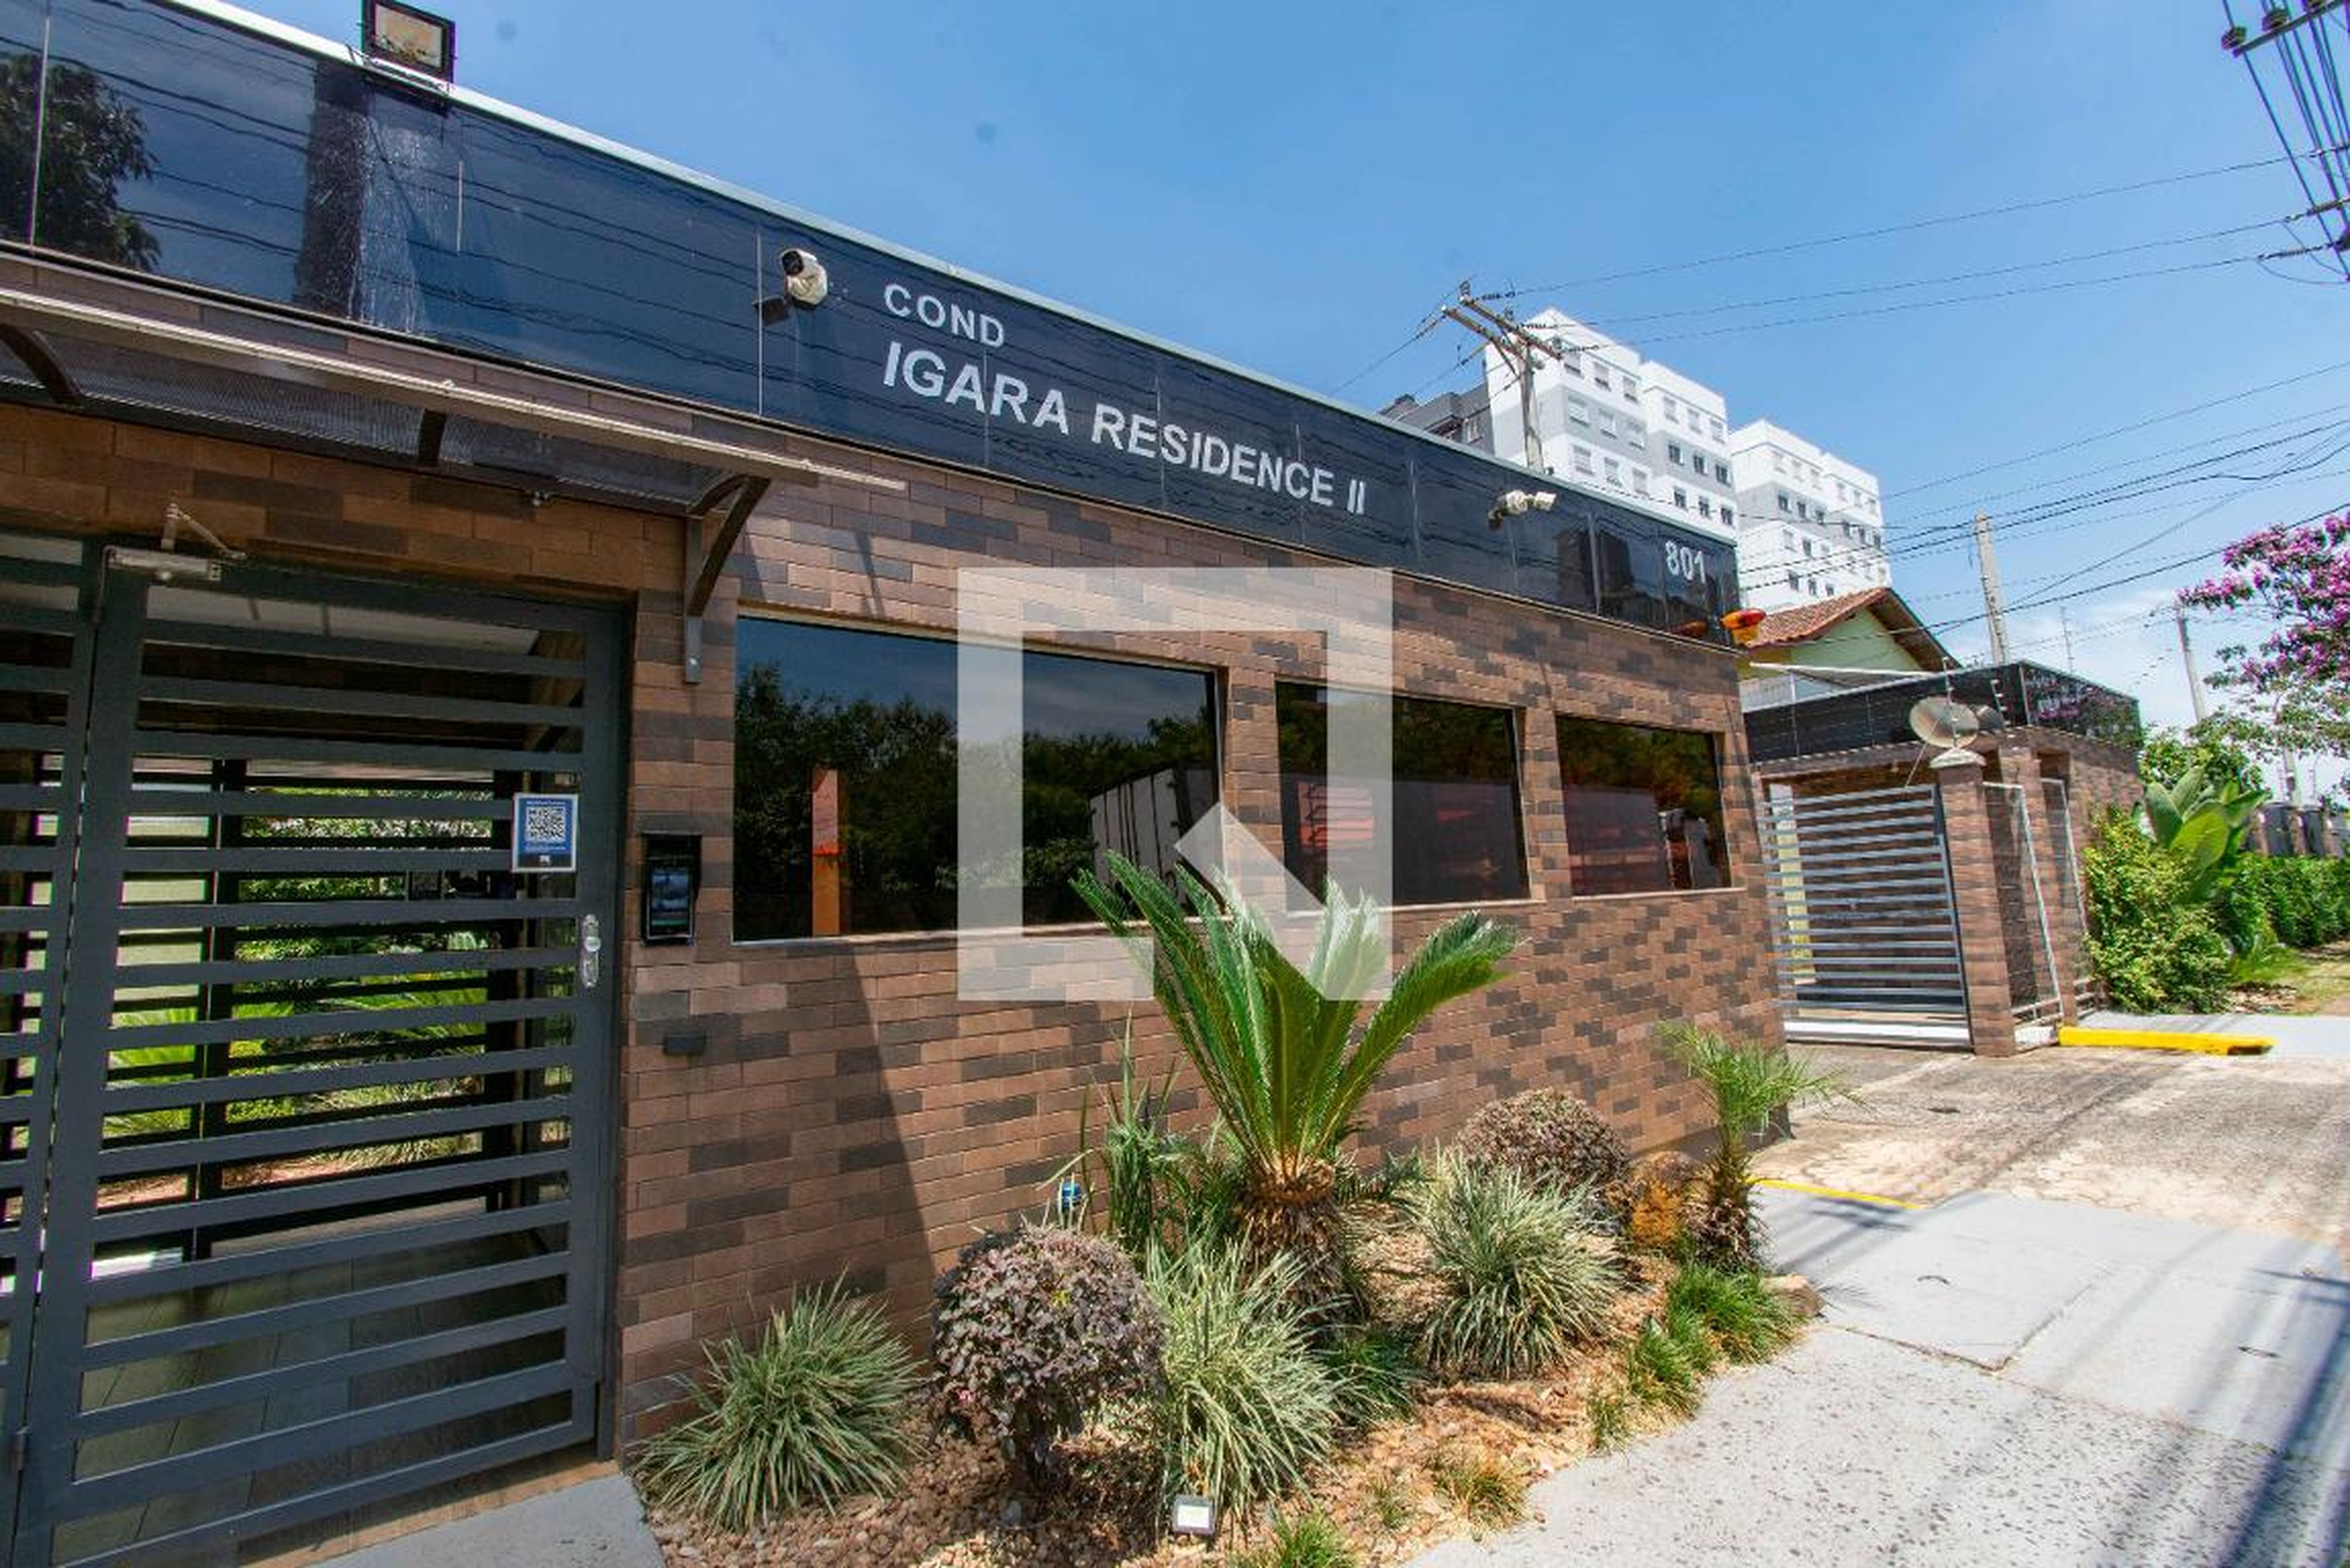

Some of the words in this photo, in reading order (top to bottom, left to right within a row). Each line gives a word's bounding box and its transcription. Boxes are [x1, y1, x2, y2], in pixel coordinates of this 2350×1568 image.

[884, 283, 1004, 347] COND
[883, 340, 1069, 435] IGARA
[1091, 403, 1335, 506] RESIDENCE
[1348, 479, 1365, 515] II
[1665, 540, 1706, 584] 801
